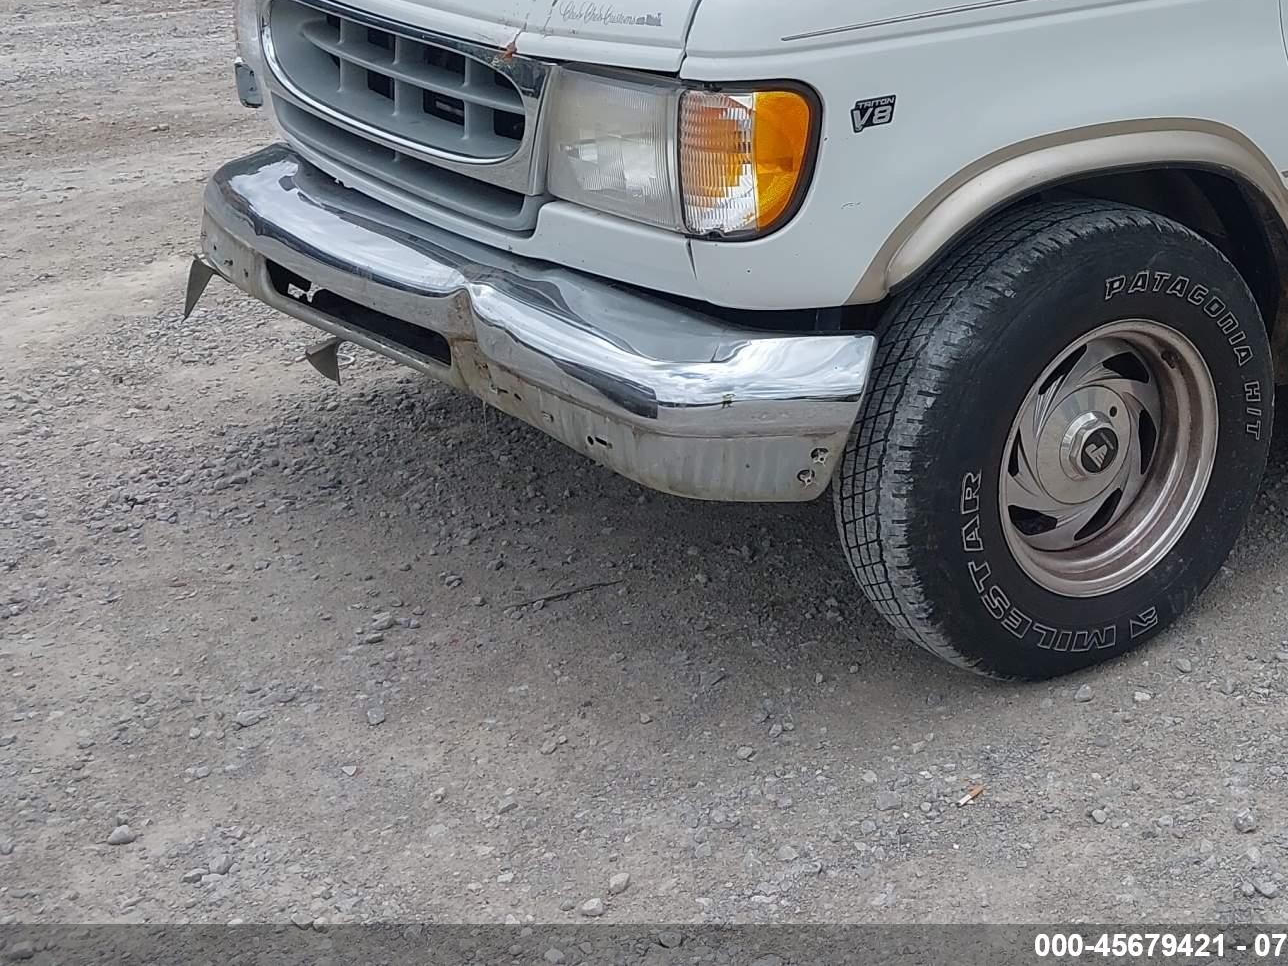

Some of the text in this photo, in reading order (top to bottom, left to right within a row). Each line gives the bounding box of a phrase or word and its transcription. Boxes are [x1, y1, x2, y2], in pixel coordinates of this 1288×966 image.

[852, 106, 892, 132] V8
[857, 97, 895, 109] TRITON
[1105, 270, 1253, 366] PATAGONIA
[960, 467, 1116, 652] MILESTAR
